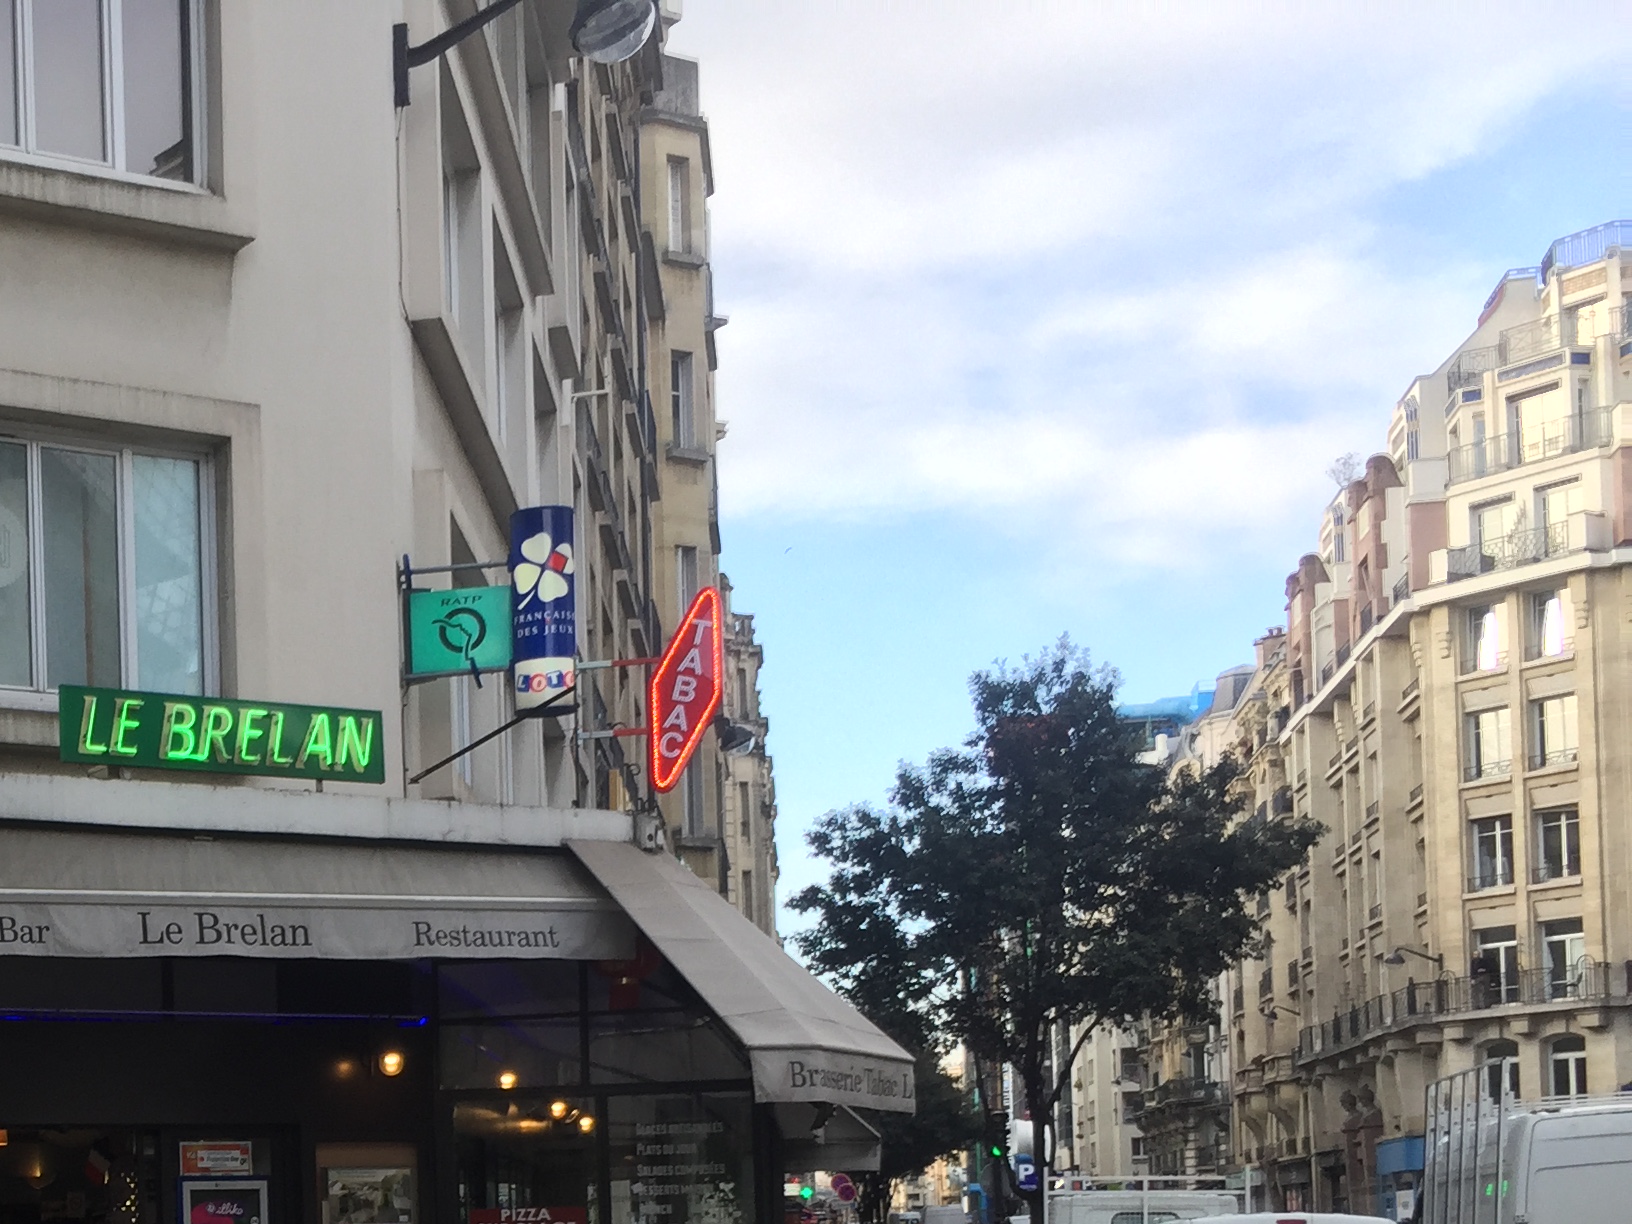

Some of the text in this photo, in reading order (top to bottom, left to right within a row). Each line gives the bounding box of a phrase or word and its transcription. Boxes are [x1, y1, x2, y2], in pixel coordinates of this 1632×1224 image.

[440, 595, 482, 607] RATP
[517, 622, 574, 638] DES JEUX
[517, 670, 575, 693] LOTO
[659, 619, 713, 758] TABAC
[77, 695, 374, 774] LE BRELAN
[137, 911, 184, 945] Le
[194, 912, 313, 947] Brelan
[412, 921, 560, 949] Restaurant
[789, 1060, 862, 1093] Brasserie
[1019, 1164, 1035, 1182] P
[500, 1208, 551, 1222] PIZZA
